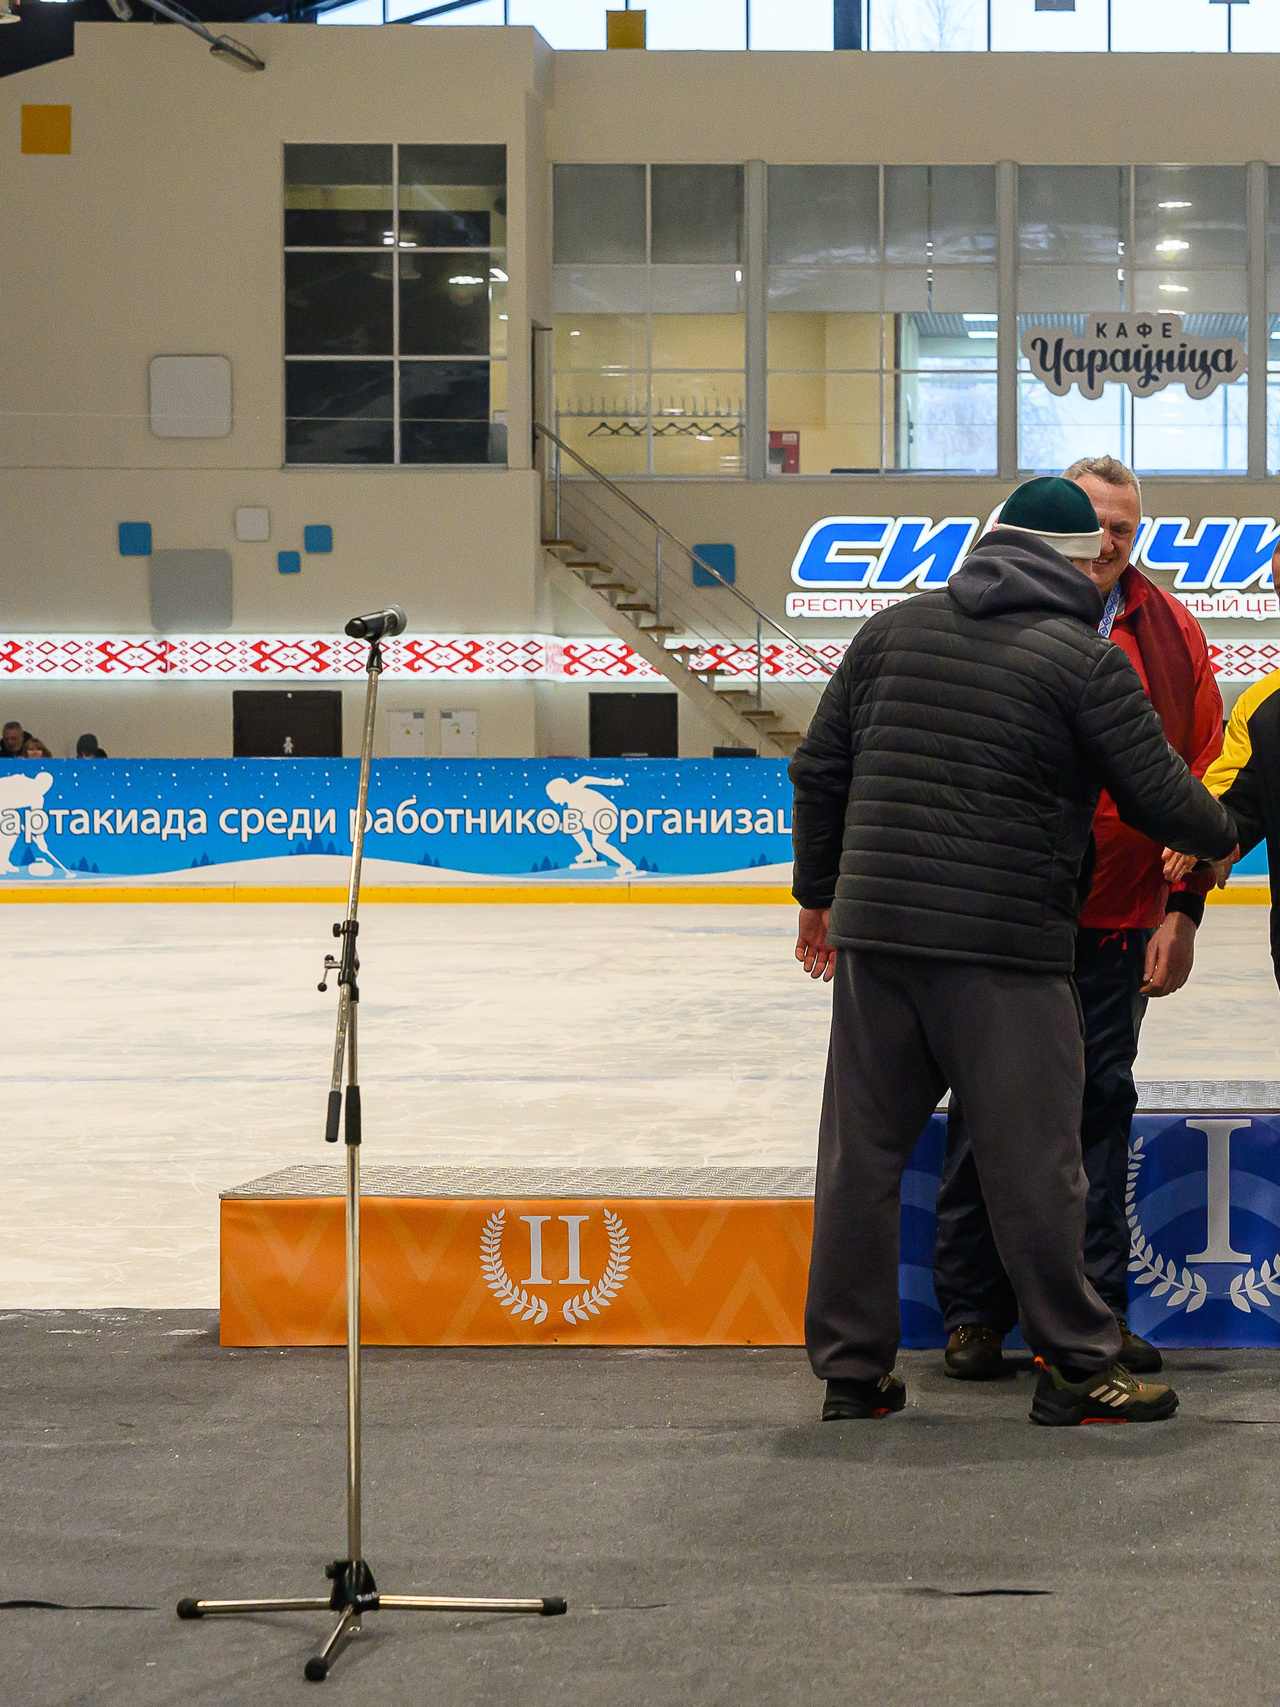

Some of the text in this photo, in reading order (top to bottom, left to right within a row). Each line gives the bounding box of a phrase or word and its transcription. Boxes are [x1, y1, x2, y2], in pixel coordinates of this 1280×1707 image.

[1096, 322, 1172, 338] КАФЕ
[1031, 337, 1238, 390] Чараўніца
[0, 807, 207, 844] артакиада
[218, 807, 337, 843] среди
[349, 798, 584, 843] работников
[1186, 1119, 1251, 1263] I
[519, 1215, 591, 1284] II
